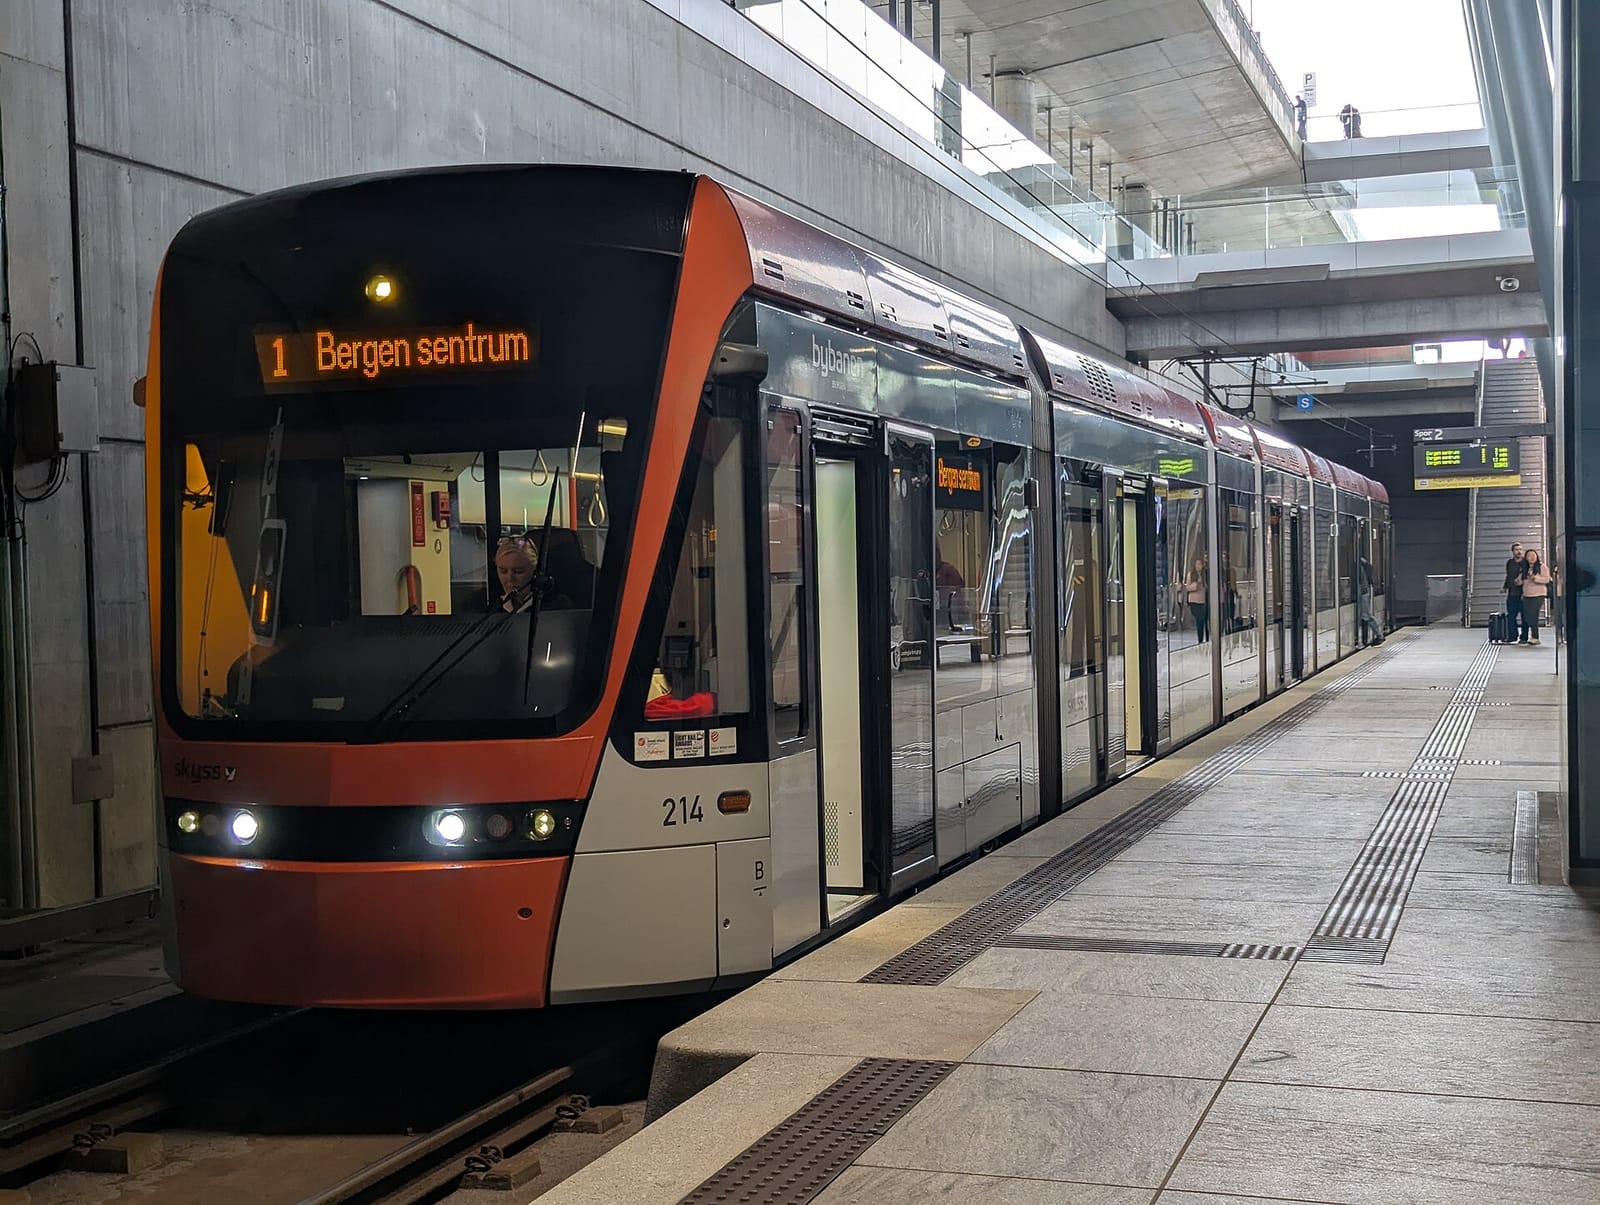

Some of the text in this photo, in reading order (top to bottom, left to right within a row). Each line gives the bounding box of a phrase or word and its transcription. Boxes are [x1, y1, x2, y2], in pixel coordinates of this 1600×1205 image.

[1305, 73, 1313, 85] P
[271, 322, 530, 378] 1 Bergen sentrum
[812, 333, 864, 378] bybanen
[1300, 397, 1310, 408] S
[1414, 429, 1443, 440] Spor 2
[662, 795, 704, 826] 214
[755, 860, 764, 880] B
